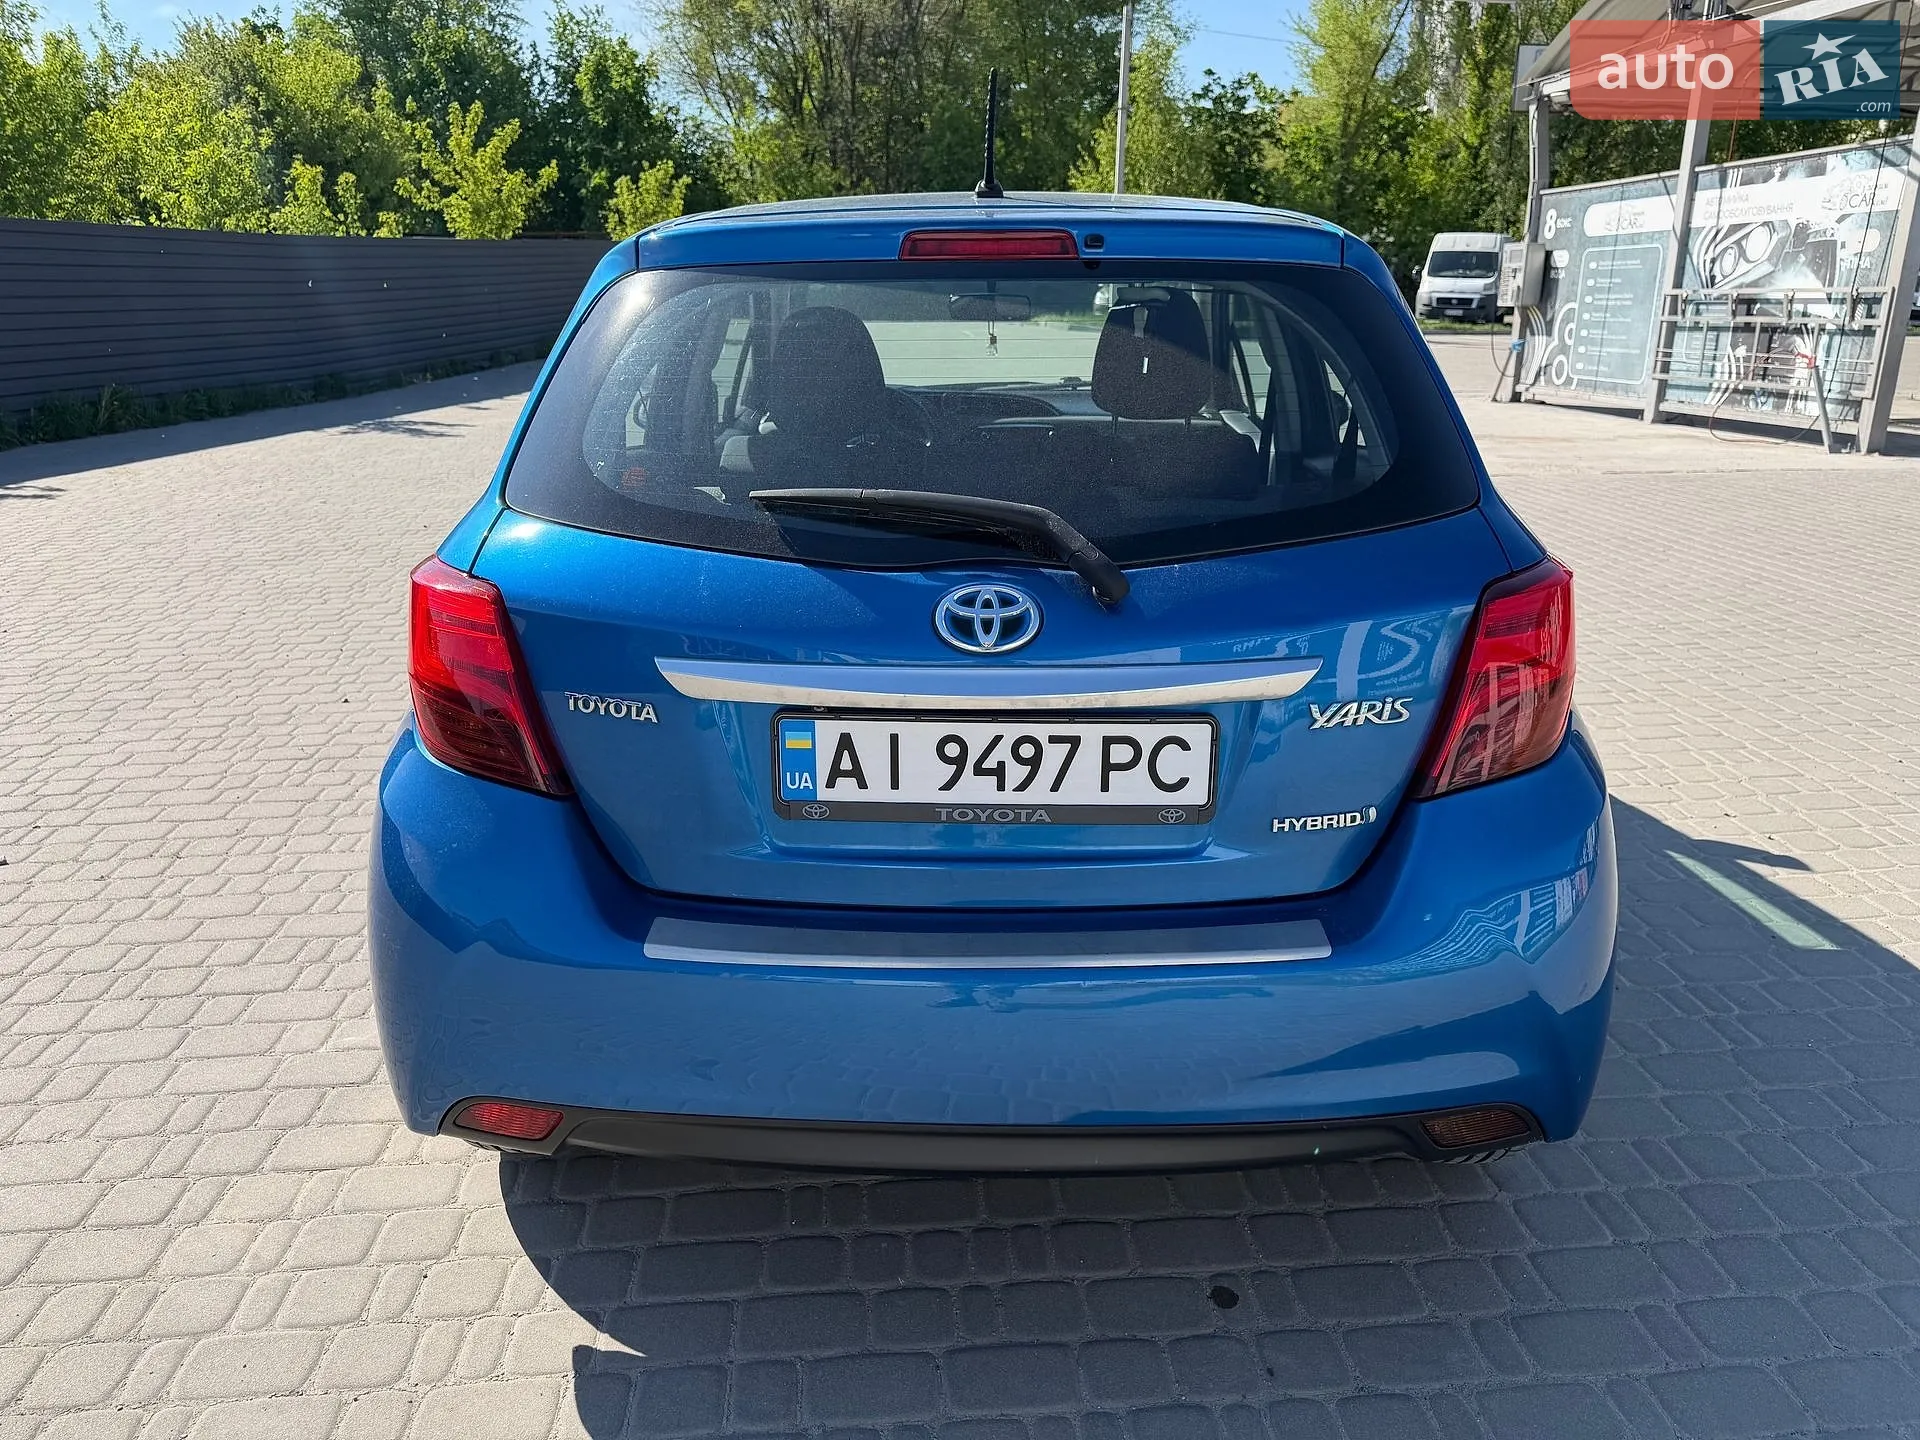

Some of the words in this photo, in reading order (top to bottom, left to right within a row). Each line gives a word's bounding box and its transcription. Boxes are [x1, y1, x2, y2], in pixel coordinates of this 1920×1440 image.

[1543, 208, 1557, 240] 8
[564, 691, 659, 724] TOYOTA
[825, 732, 900, 791] AI
[935, 733, 1083, 793] 9497
[1099, 735, 1192, 793] PC
[786, 772, 814, 790] UA
[935, 807, 1052, 823] TOYOTA
[1272, 811, 1363, 833] HYBRID
